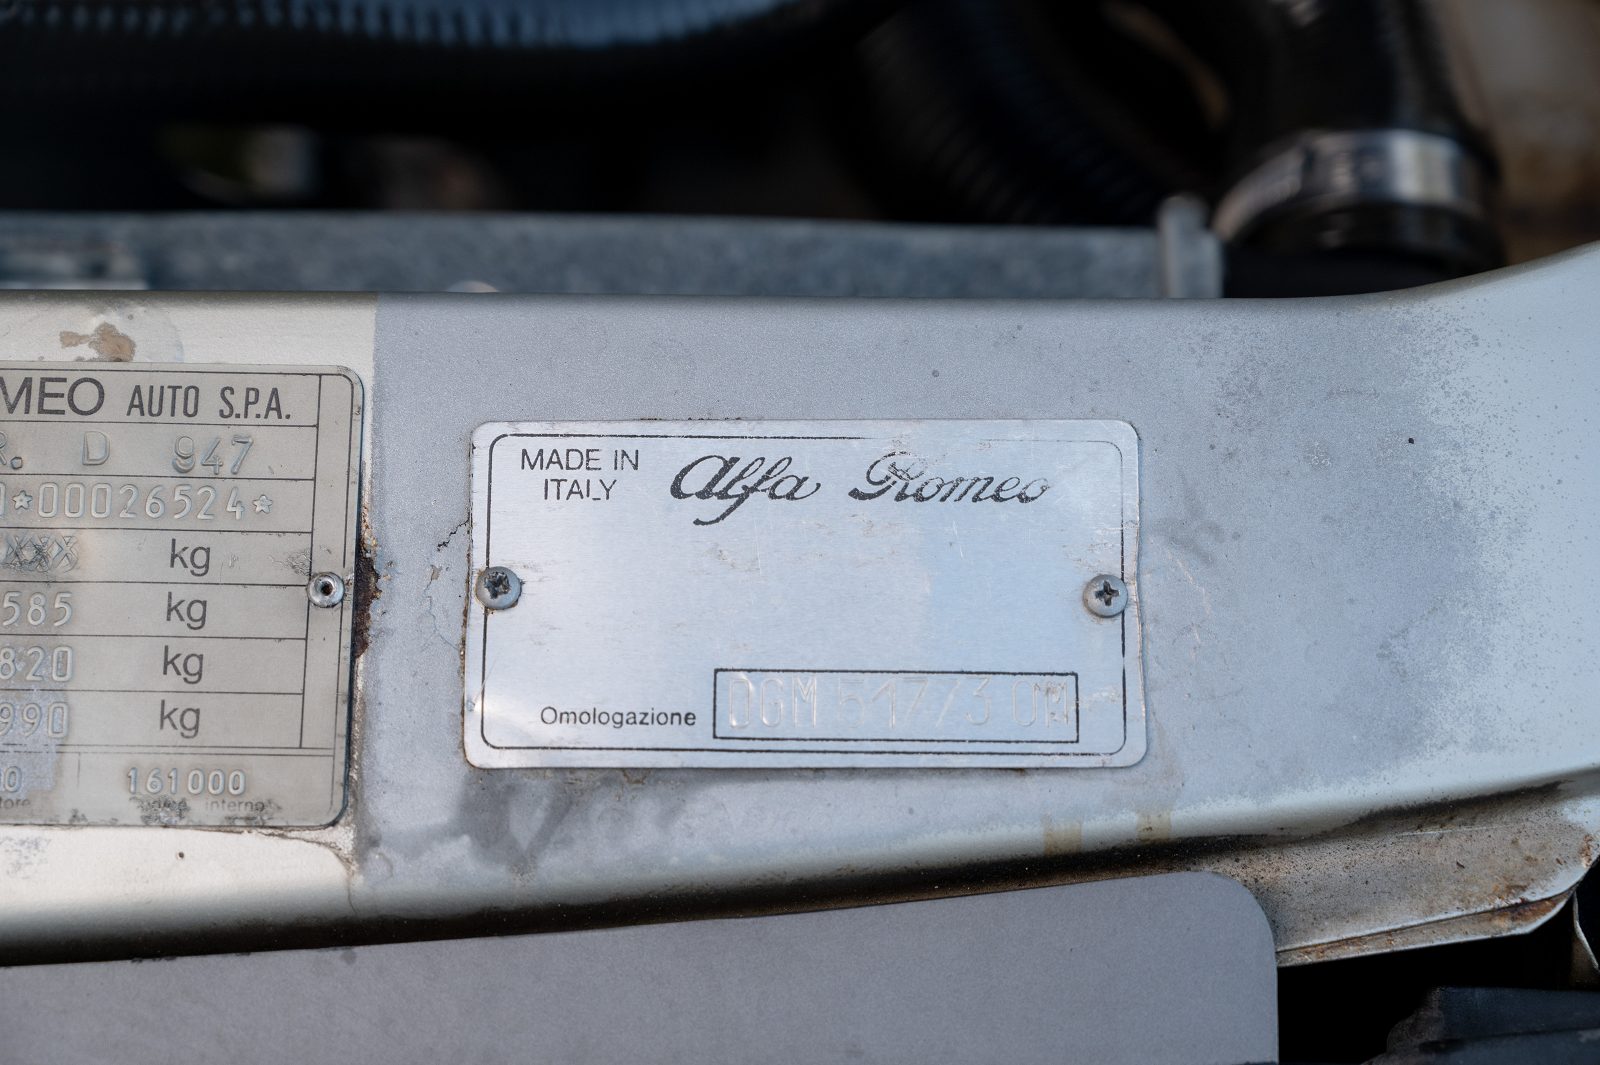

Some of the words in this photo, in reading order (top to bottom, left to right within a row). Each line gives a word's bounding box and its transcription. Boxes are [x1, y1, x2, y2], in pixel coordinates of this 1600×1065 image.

[126, 385, 200, 417] AUTO
[218, 386, 291, 420] S.P.A.
[81, 431, 111, 466] D
[171, 435, 254, 475] 947
[520, 448, 602, 472] MADE
[614, 449, 639, 472] IN
[543, 478, 618, 502] ITALY
[670, 455, 822, 526] Alfa
[848, 451, 1051, 504] Romeo
[169, 538, 211, 576] kg
[166, 591, 207, 630] kg
[163, 645, 204, 684] kg
[159, 699, 200, 739] kg
[539, 706, 697, 730] Omologazione
[728, 675, 818, 729] DGM
[126, 766, 247, 796] 161000
